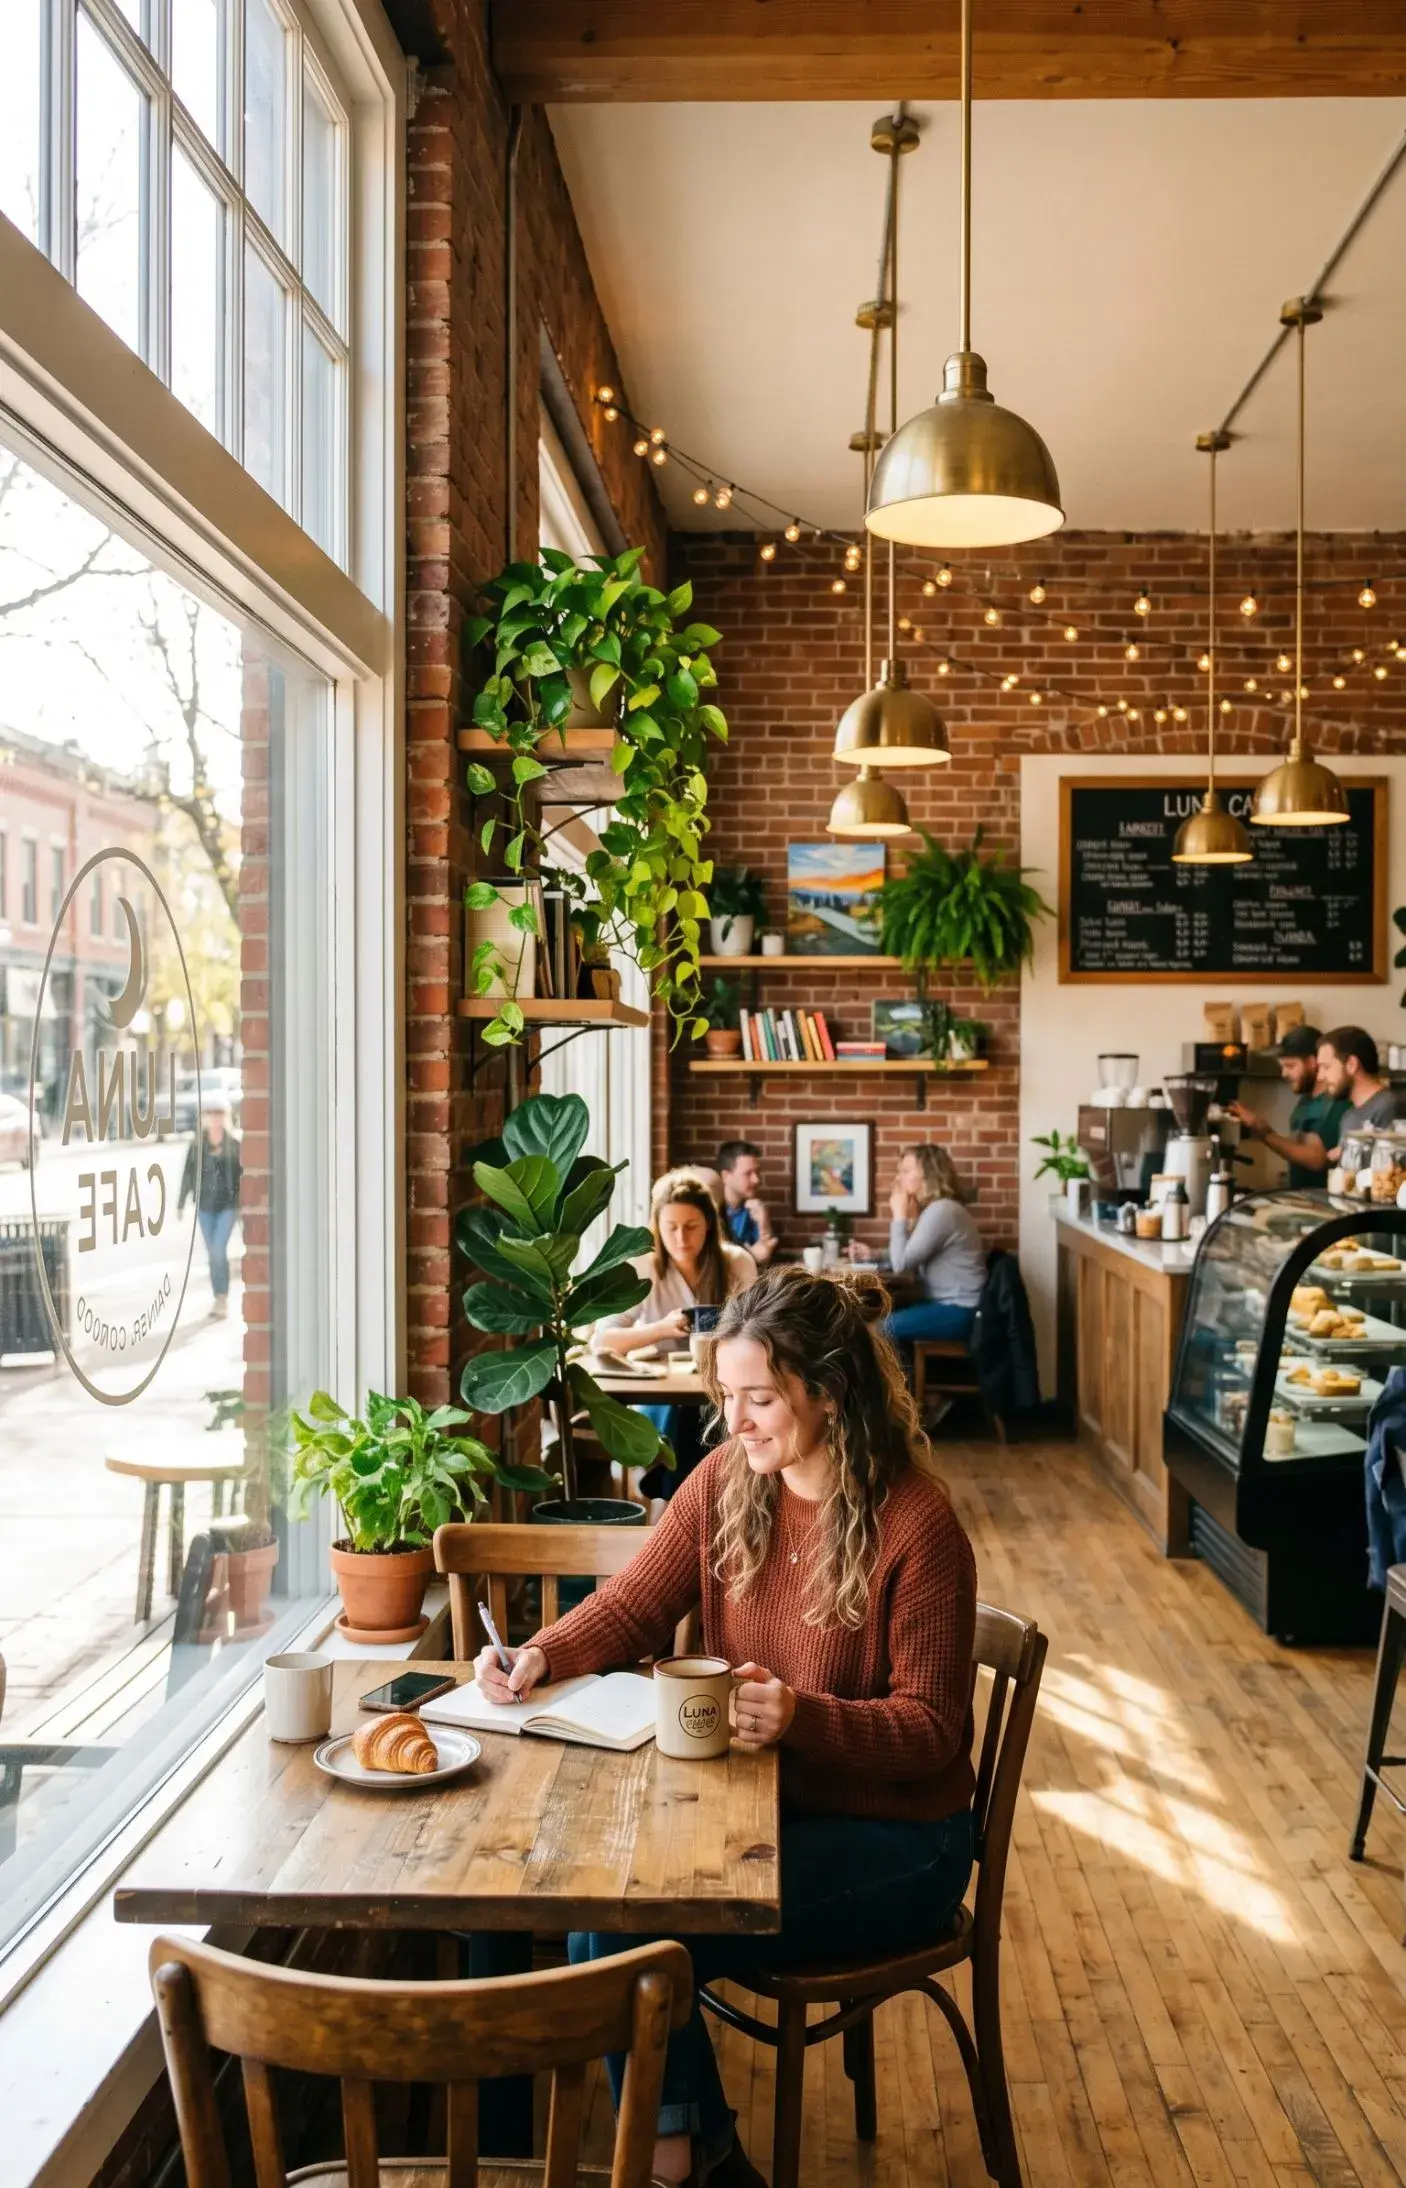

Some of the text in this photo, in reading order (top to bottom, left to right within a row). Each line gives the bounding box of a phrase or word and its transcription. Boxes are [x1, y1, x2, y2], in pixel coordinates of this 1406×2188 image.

[1164, 794, 1253, 817] LUN CA
[684, 1706, 717, 1719] LUNA
